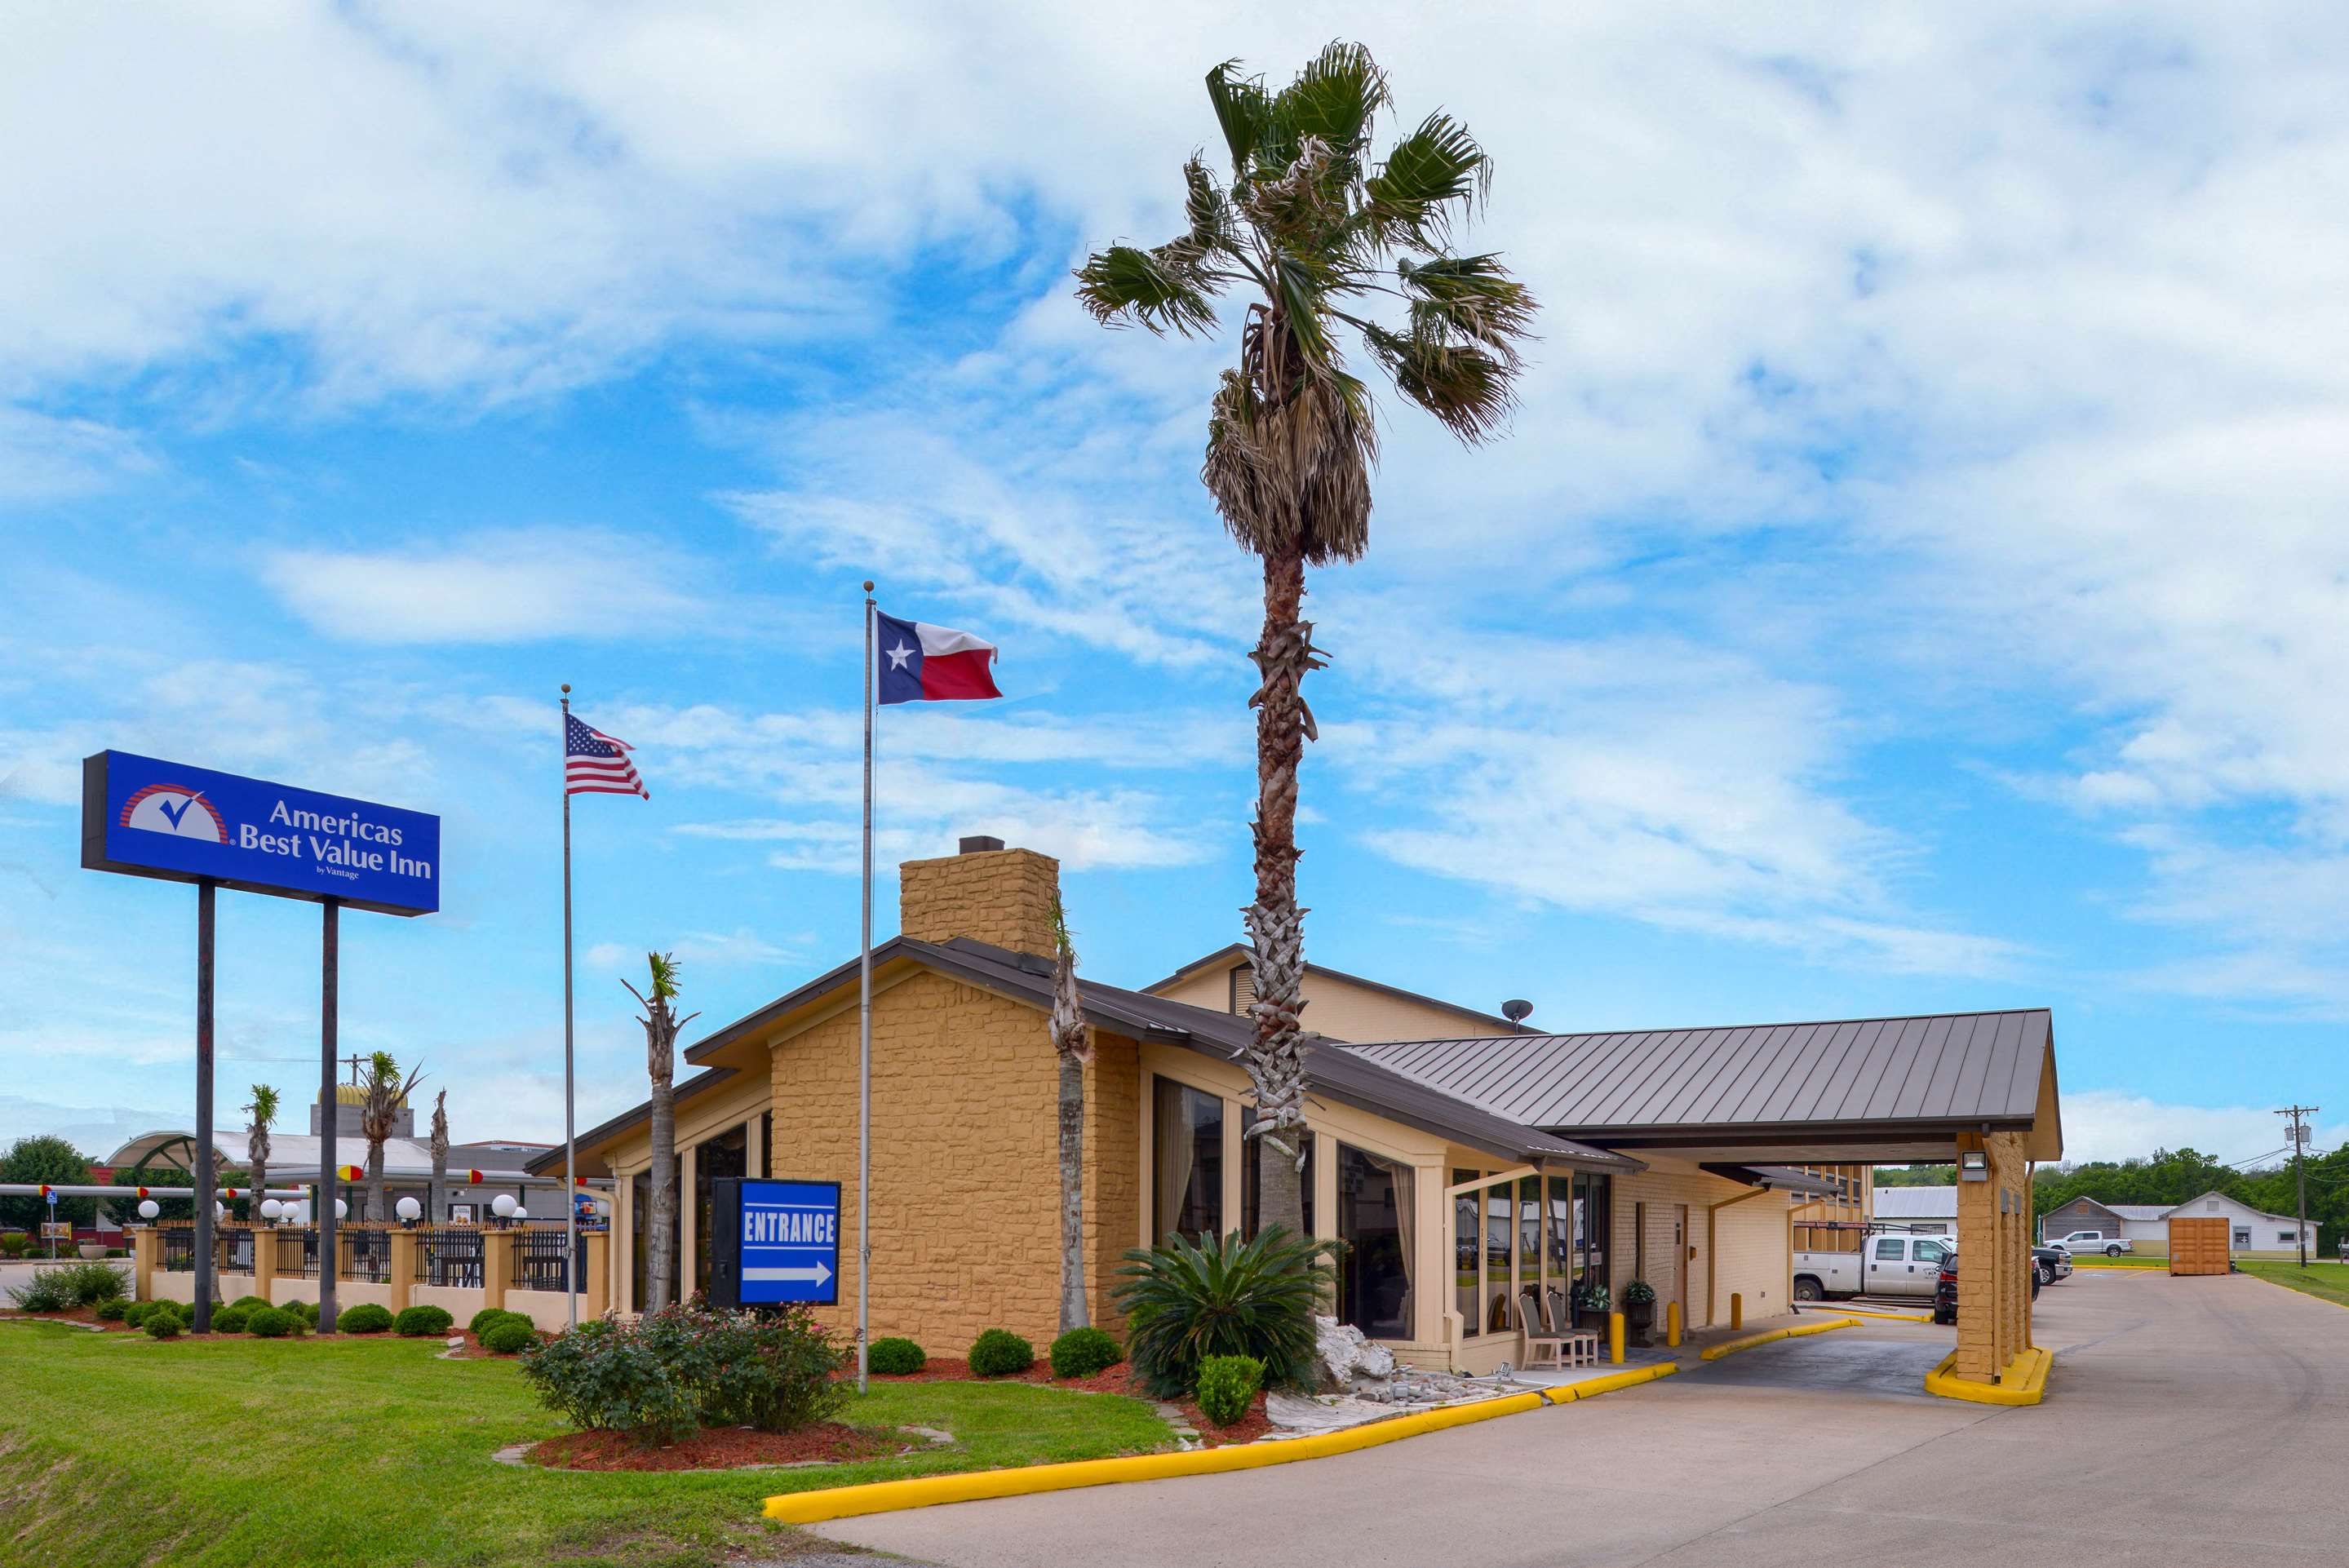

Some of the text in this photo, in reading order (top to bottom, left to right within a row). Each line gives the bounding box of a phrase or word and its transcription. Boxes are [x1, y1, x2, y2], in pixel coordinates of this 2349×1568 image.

[269, 800, 402, 846] Americas
[240, 823, 431, 879] Best Value Inn
[317, 866, 359, 881] by Vantage
[744, 1211, 835, 1243] ENTRANCE
